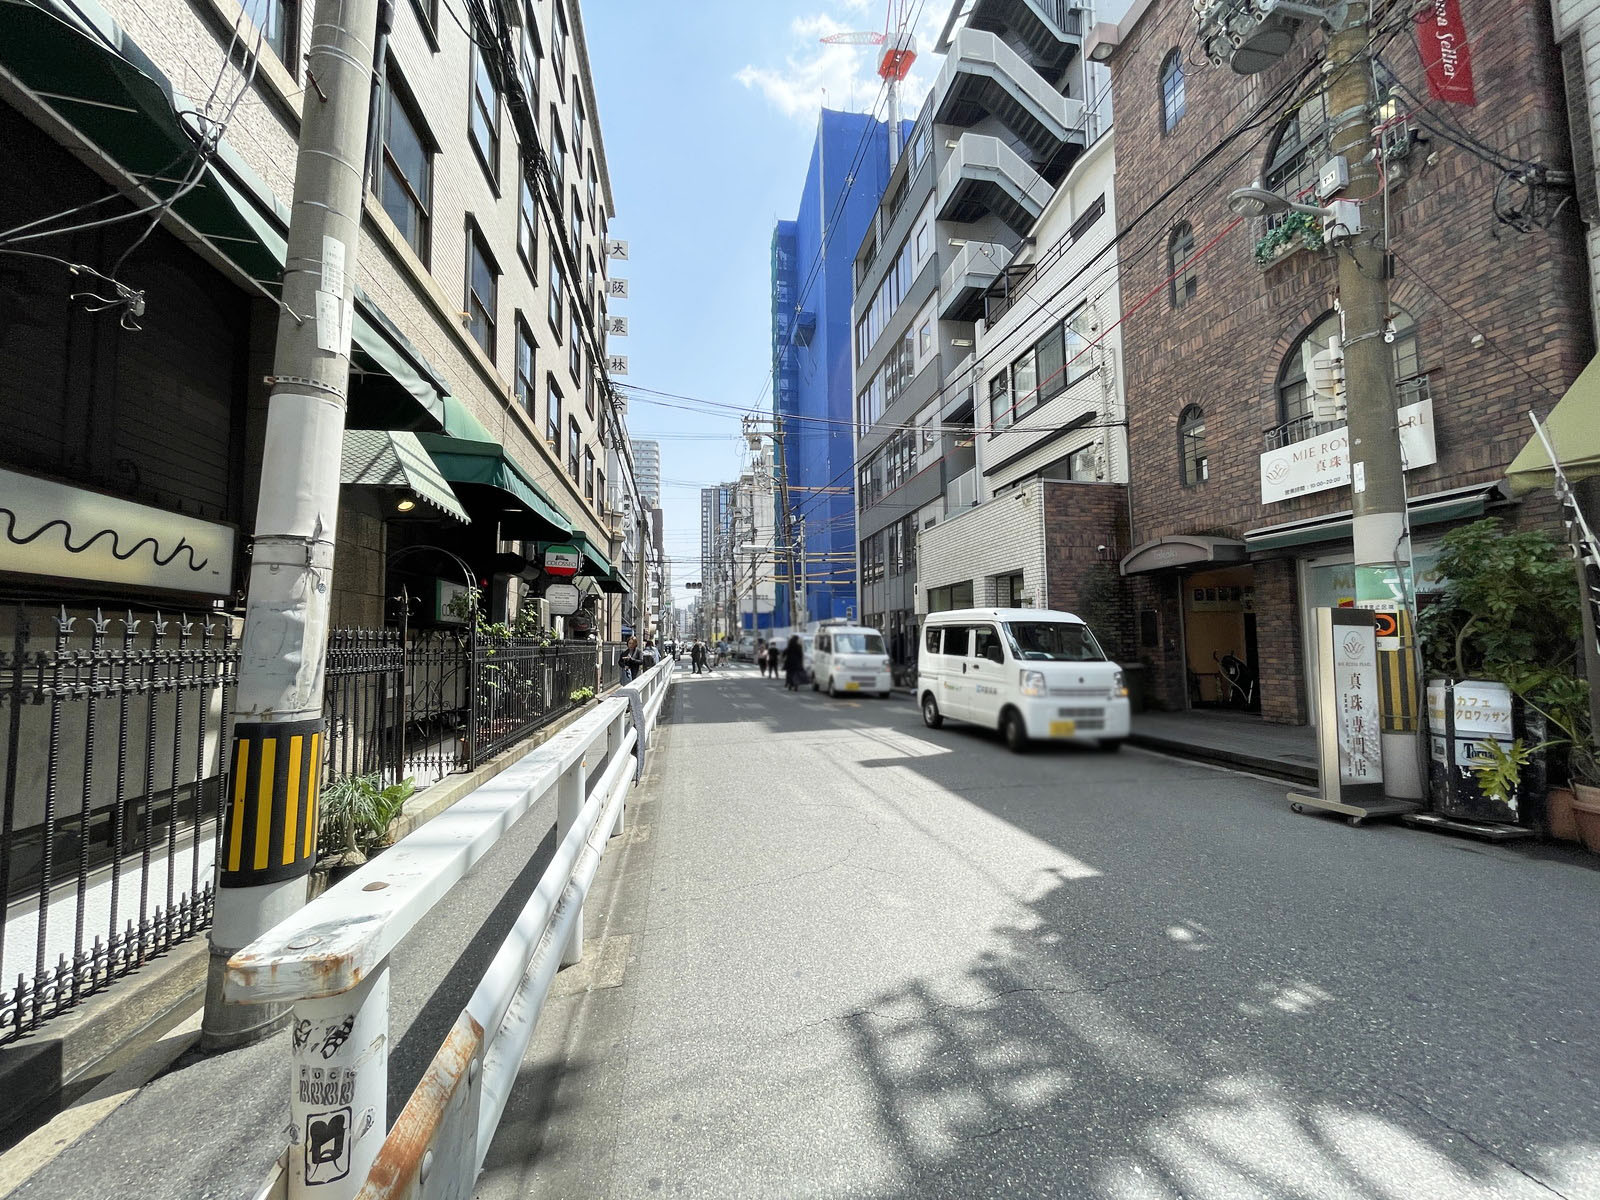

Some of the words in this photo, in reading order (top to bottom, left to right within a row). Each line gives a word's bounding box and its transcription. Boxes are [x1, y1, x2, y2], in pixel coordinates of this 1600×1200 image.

[1436, 30, 1457, 79] Sellier
[1292, 446, 1317, 463] MIE
[1321, 437, 1348, 454] ROY
[1316, 455, 1350, 472] 真珠
[1457, 696, 1491, 708] カフェ
[1348, 672, 1368, 777] 真珠専門店
[1456, 710, 1509, 722] クロワッサン
